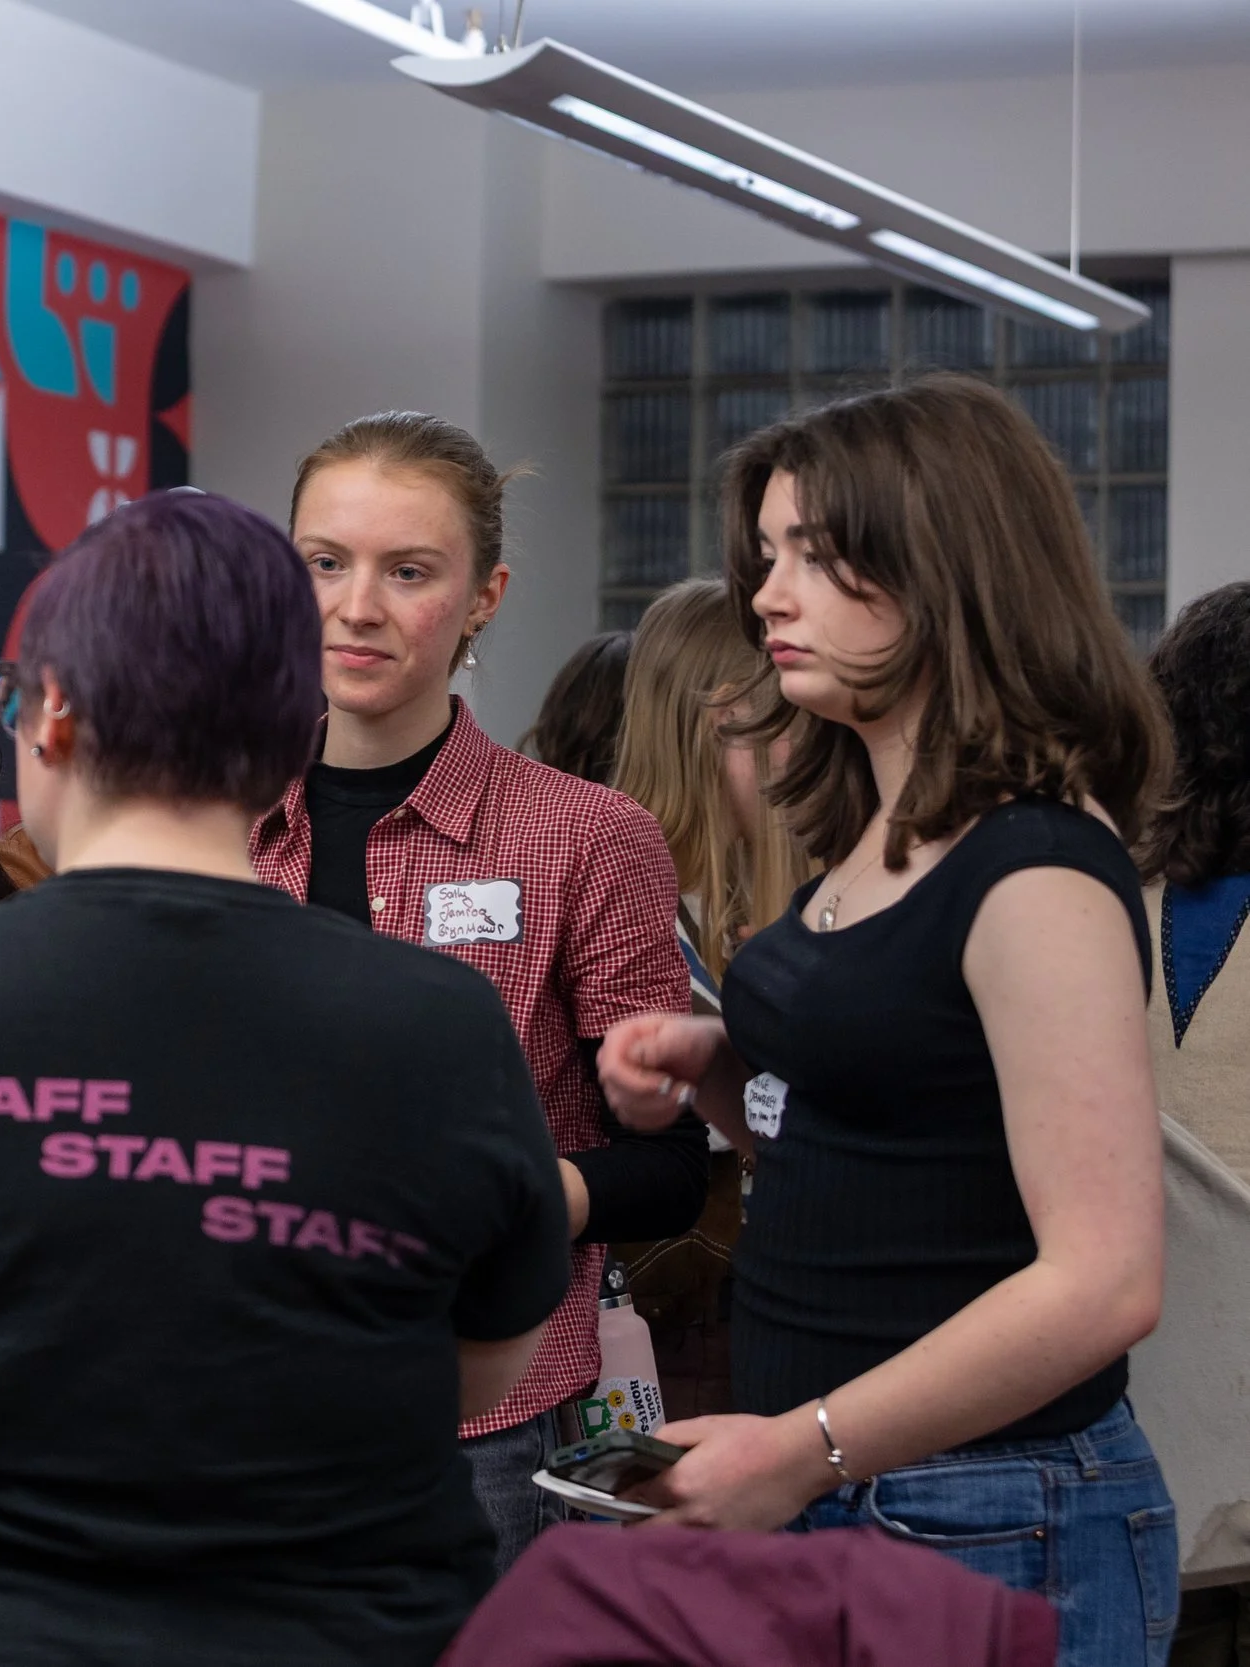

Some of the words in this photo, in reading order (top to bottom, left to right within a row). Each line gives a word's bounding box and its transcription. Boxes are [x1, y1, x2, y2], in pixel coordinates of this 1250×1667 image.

[438, 923, 464, 939] Bryn
[466, 923, 504, 936] Mawr
[39, 1131, 291, 1189] STAFF
[643, 1384, 656, 1421] YOUR
